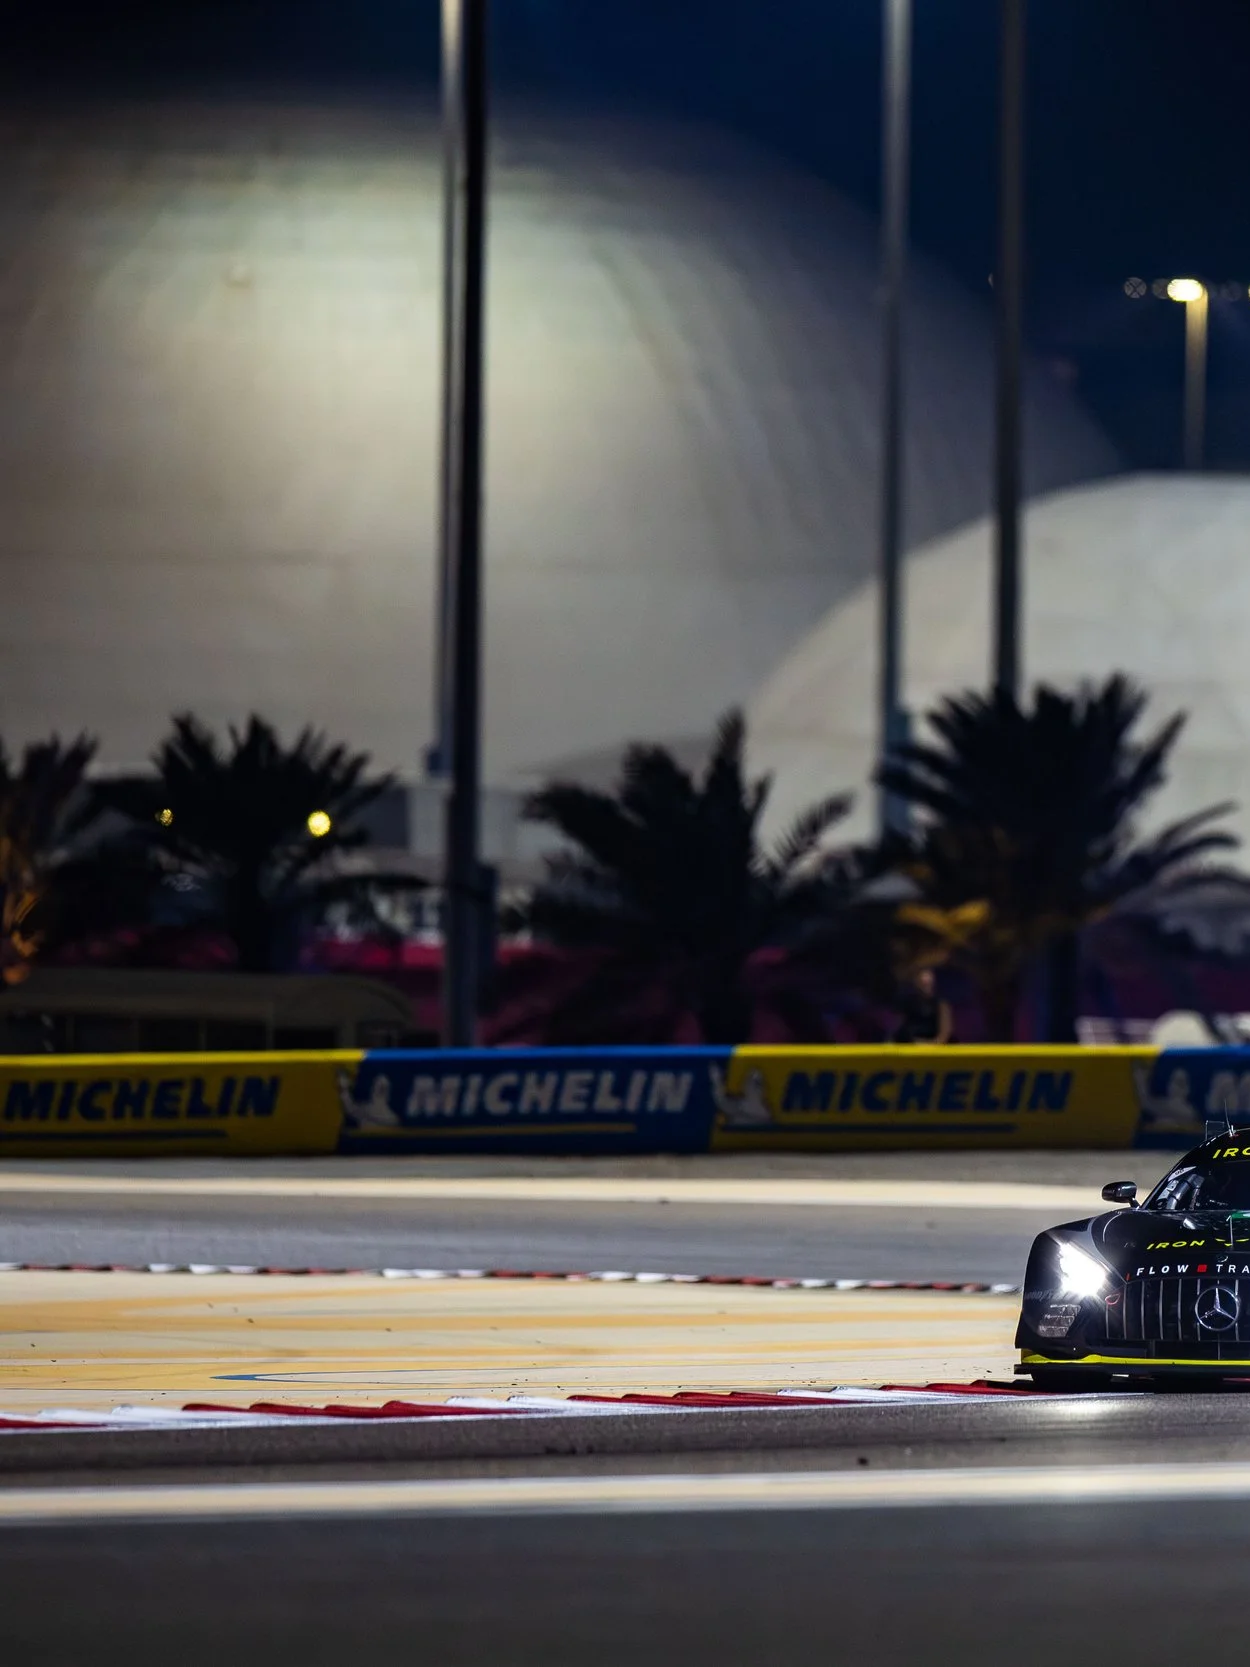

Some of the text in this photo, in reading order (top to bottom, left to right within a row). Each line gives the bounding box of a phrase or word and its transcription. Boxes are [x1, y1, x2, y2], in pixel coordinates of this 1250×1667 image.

[5, 1076, 280, 1120] MICHELIN
[405, 1070, 694, 1117] MICHELIN
[781, 1071, 1072, 1112] MICHELIN
[1146, 1239, 1205, 1250] IRON
[1136, 1264, 1190, 1276] FLOW
